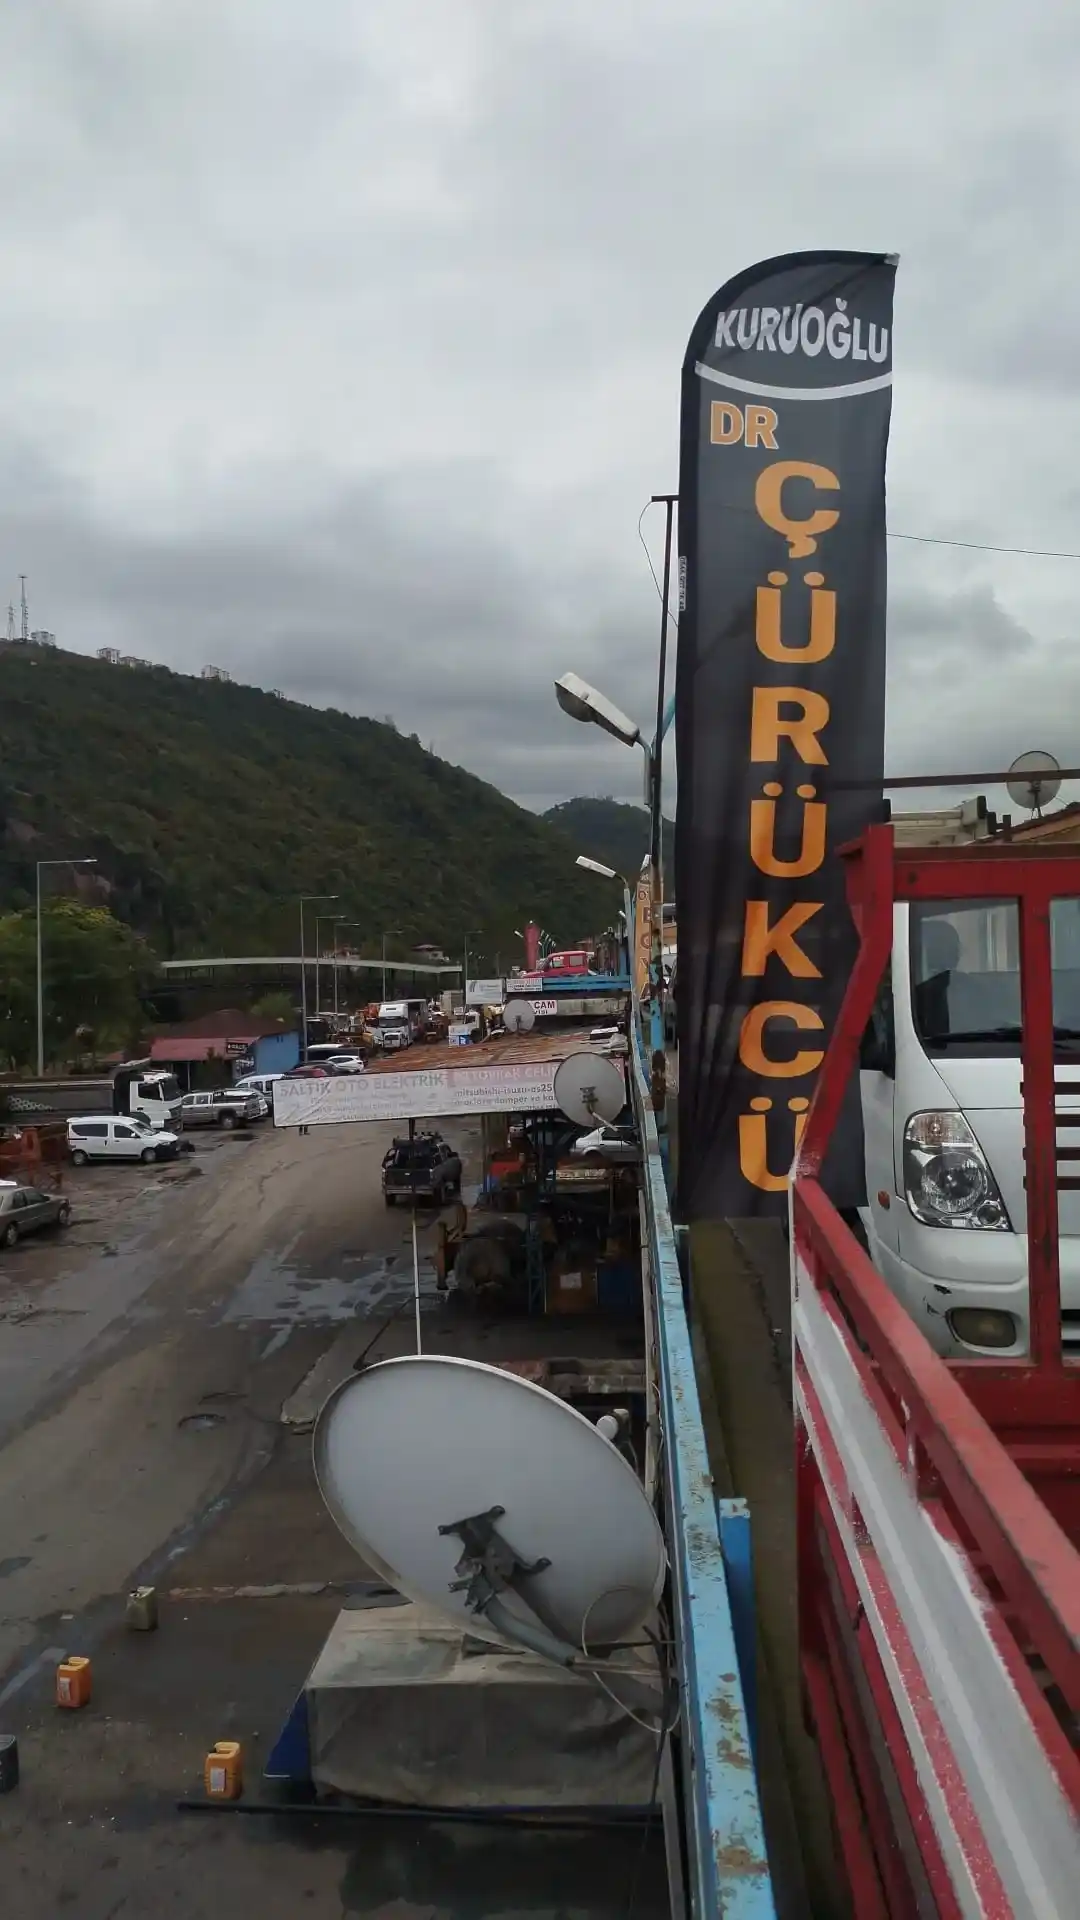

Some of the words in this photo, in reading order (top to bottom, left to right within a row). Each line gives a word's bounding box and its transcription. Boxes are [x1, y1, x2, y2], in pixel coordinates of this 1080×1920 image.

[714, 298, 888, 364] KURUOĞLU
[710, 401, 779, 449] DR
[534, 1001, 555, 1009] CAM
[335, 1078, 369, 1093] OTO
